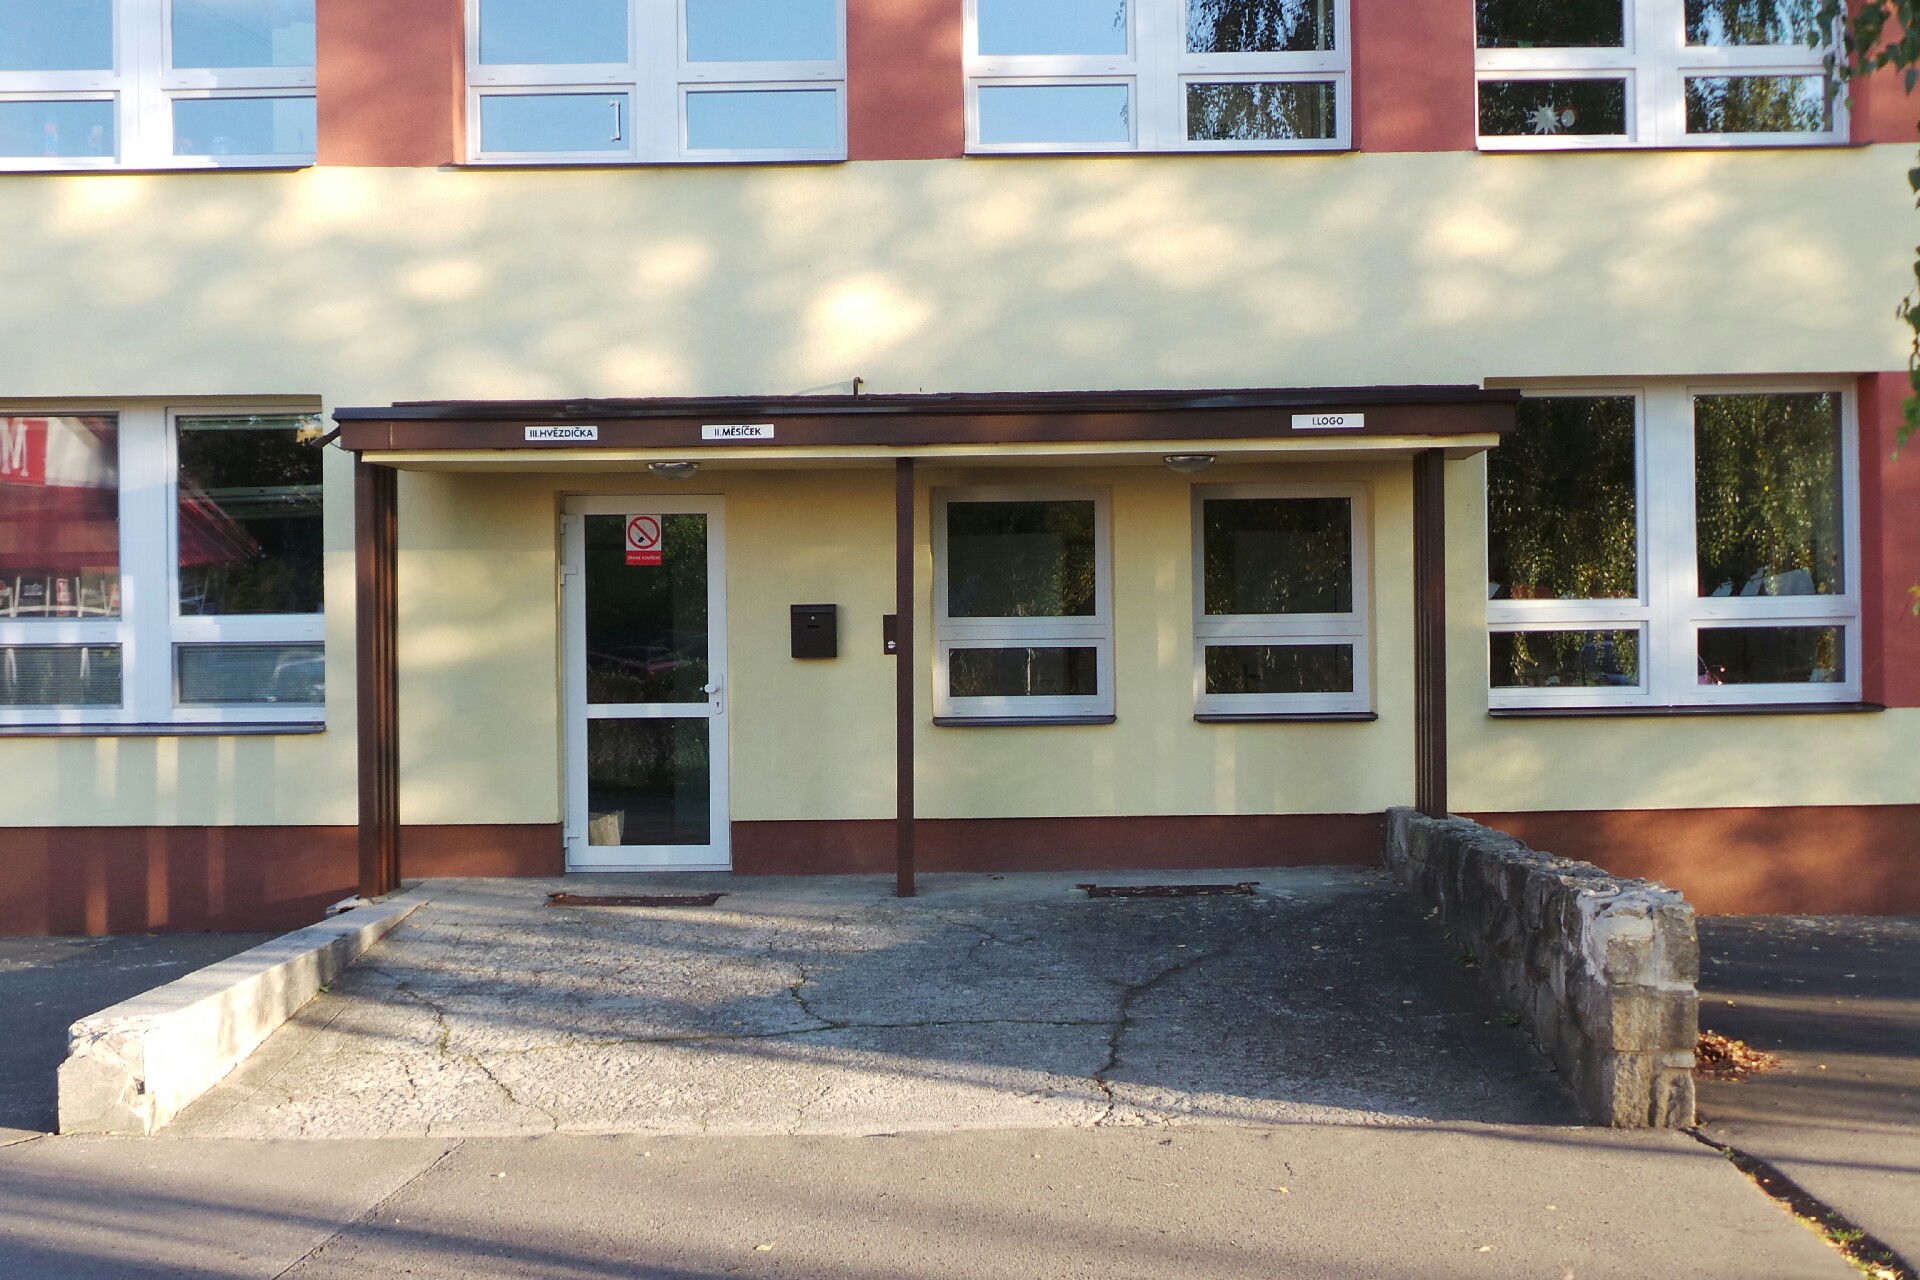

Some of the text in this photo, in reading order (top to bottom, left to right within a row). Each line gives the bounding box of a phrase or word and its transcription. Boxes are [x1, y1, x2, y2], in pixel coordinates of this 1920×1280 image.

[1312, 416, 1344, 426] I.LOGO
[529, 426, 594, 438] III.HVĚZDIČKA
[714, 425, 762, 437] II.MĚSÍČEK
